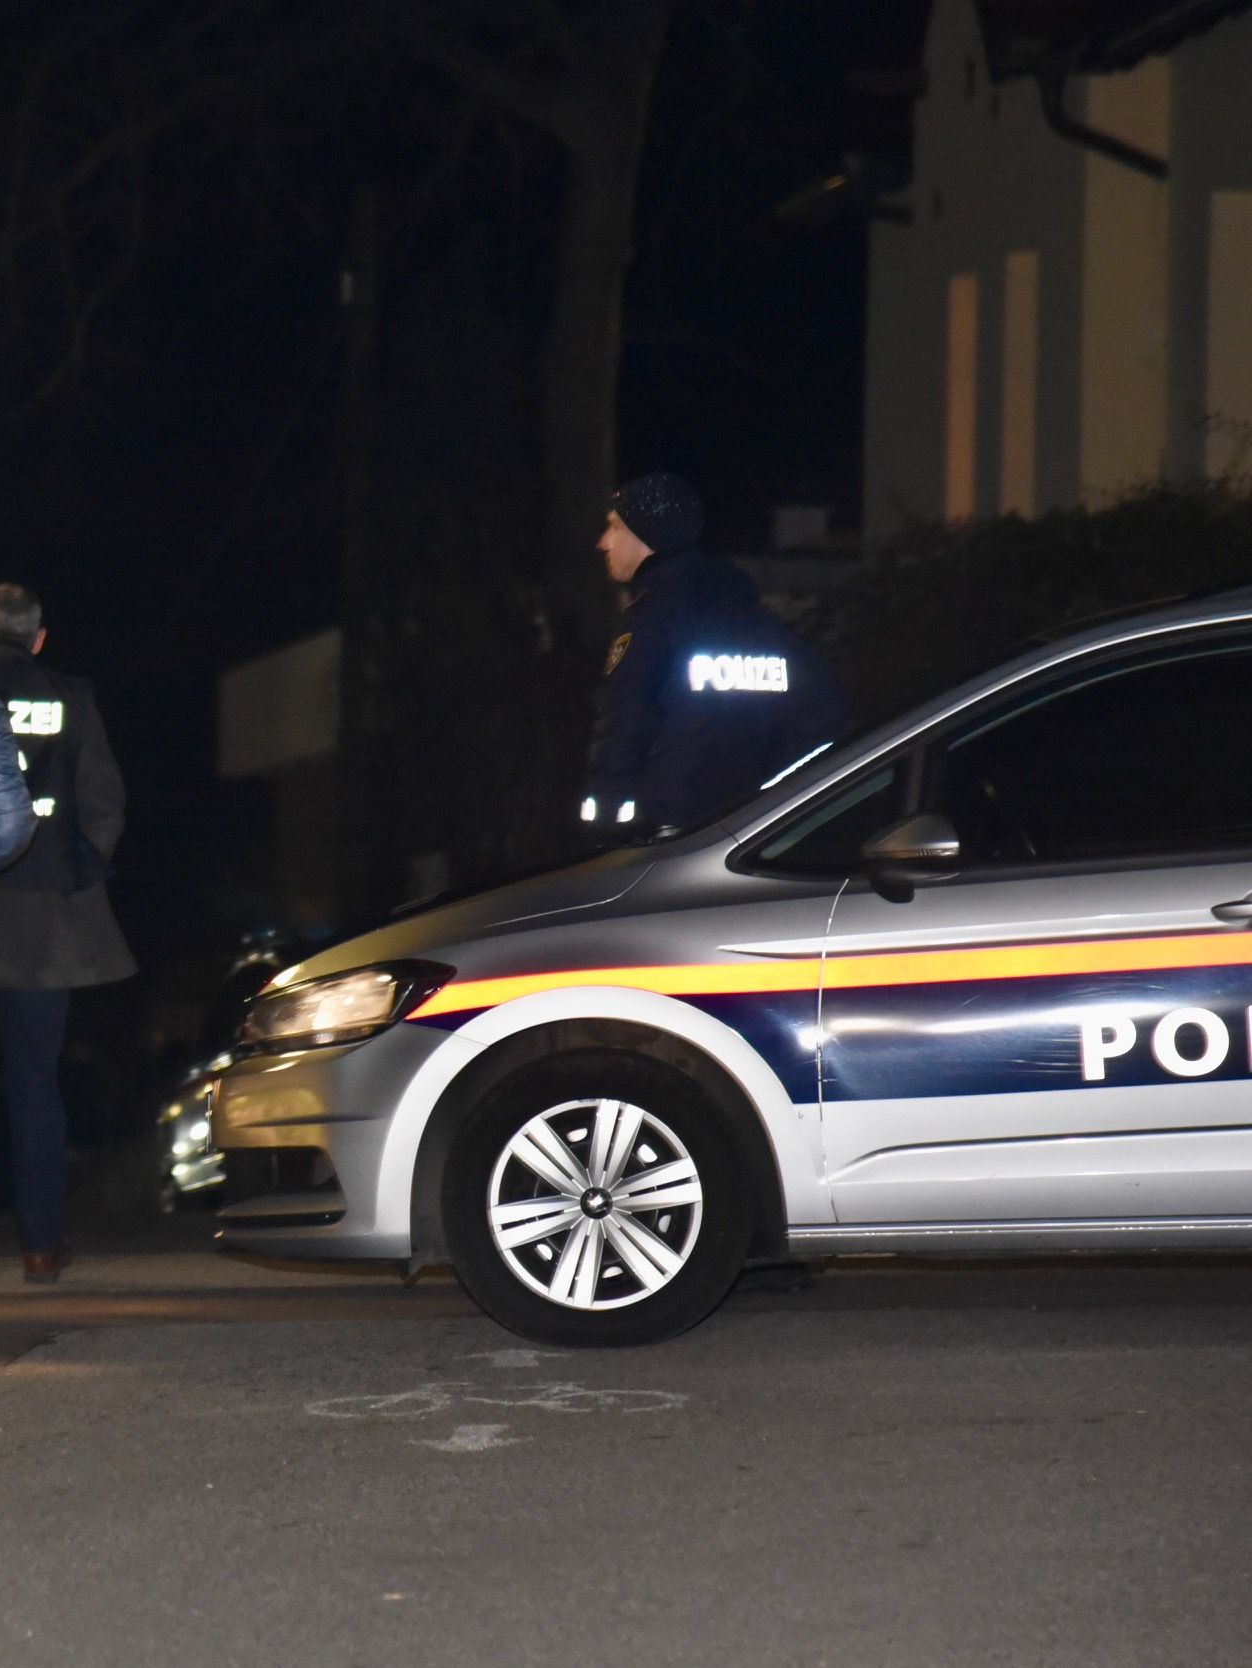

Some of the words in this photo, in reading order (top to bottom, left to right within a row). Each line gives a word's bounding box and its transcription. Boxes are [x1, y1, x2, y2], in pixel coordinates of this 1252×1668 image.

[688, 654, 788, 692] POLIZEI
[8, 700, 63, 734] ZEI
[1081, 1005, 1252, 1081] PO
